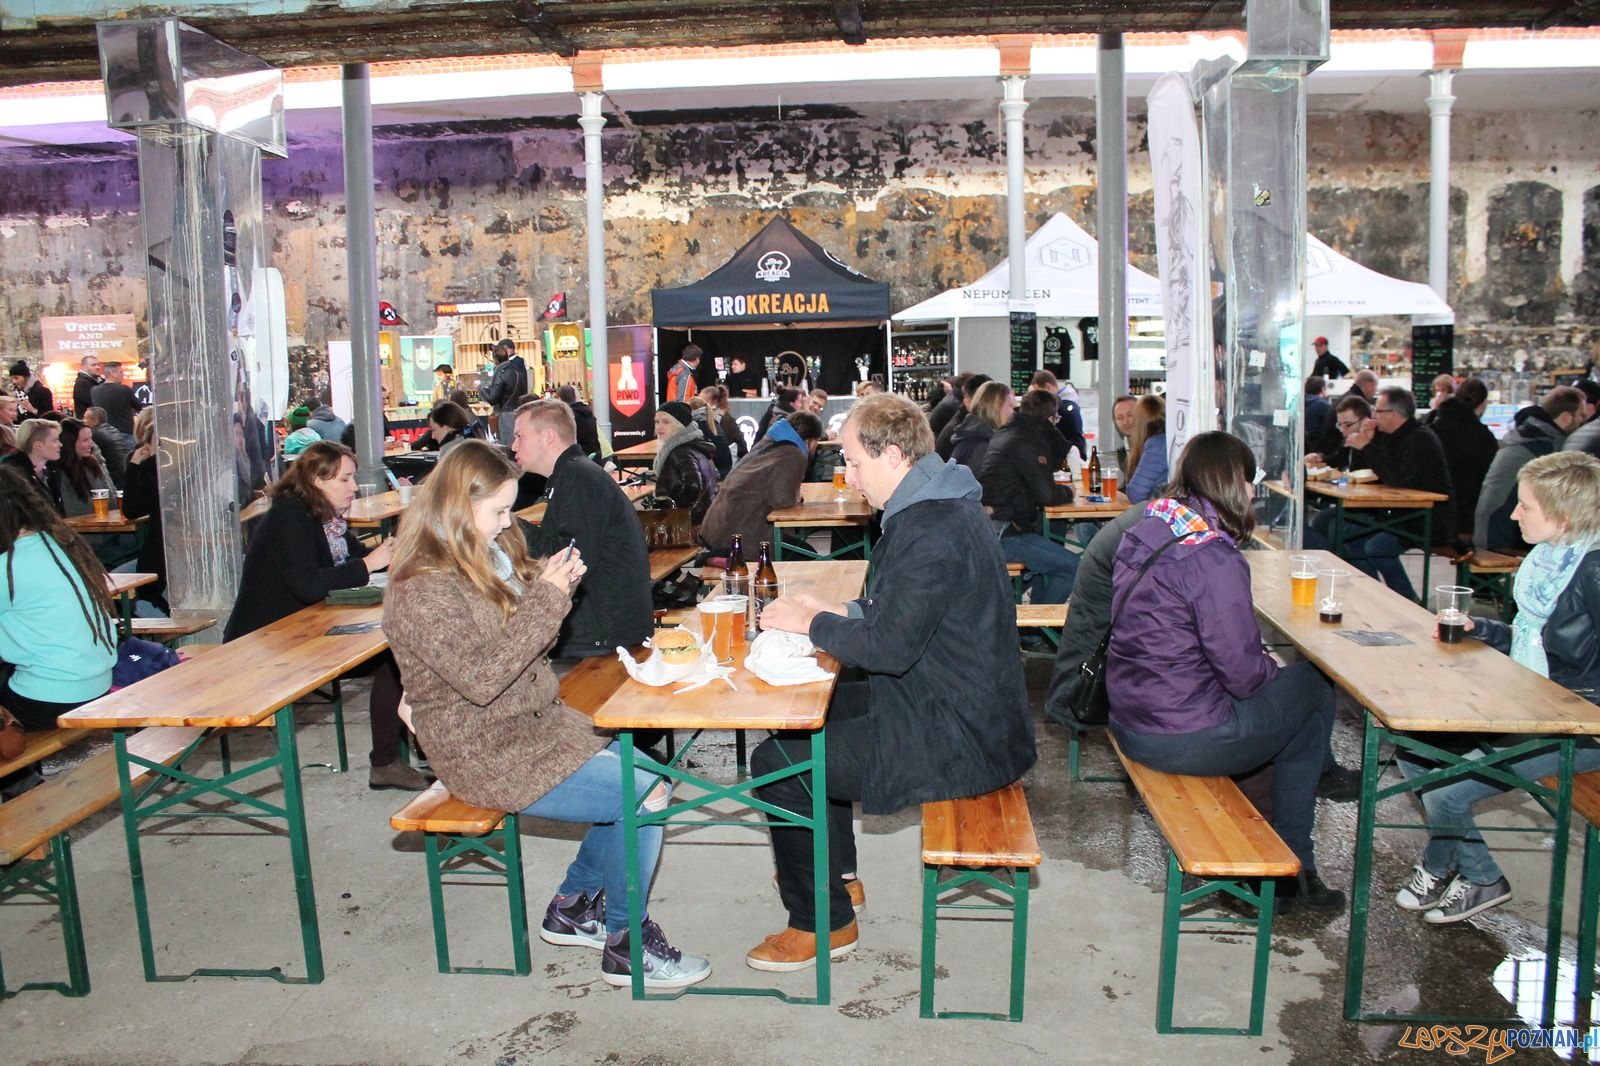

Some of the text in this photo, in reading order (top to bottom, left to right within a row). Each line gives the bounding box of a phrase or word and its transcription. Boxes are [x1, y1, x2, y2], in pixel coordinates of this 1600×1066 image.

[963, 289, 1051, 299] NEPOMCEN
[710, 293, 830, 316] BROKREACJA
[64, 322, 116, 332] UNCLE
[58, 340, 123, 350] NEPHEW
[617, 390, 639, 400] PIWO
